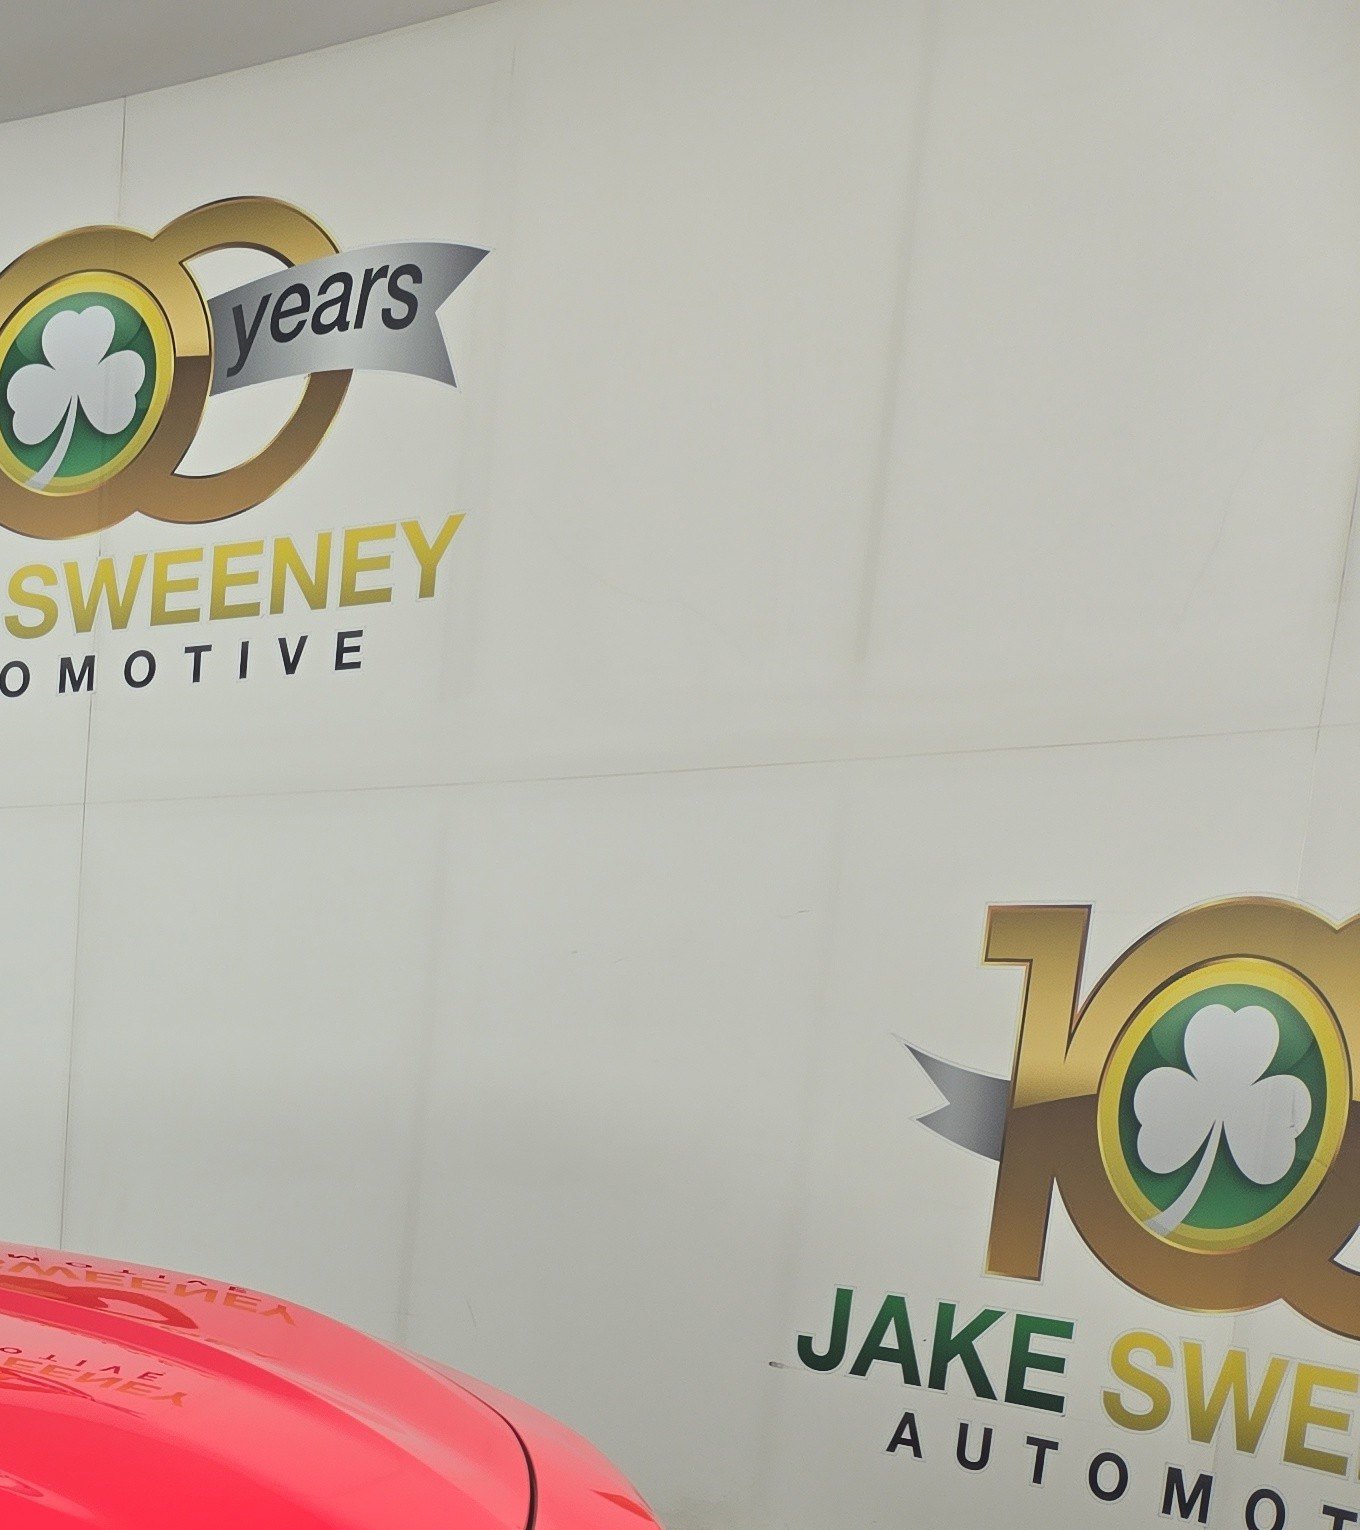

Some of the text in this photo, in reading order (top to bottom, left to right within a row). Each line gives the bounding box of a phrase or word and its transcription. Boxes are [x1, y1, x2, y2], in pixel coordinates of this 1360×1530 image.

[226, 262, 423, 378] years
[4, 512, 467, 640] SWEENEY
[983, 895, 1360, 1341] 10
[796, 1287, 1360, 1478] JAKE SWE
